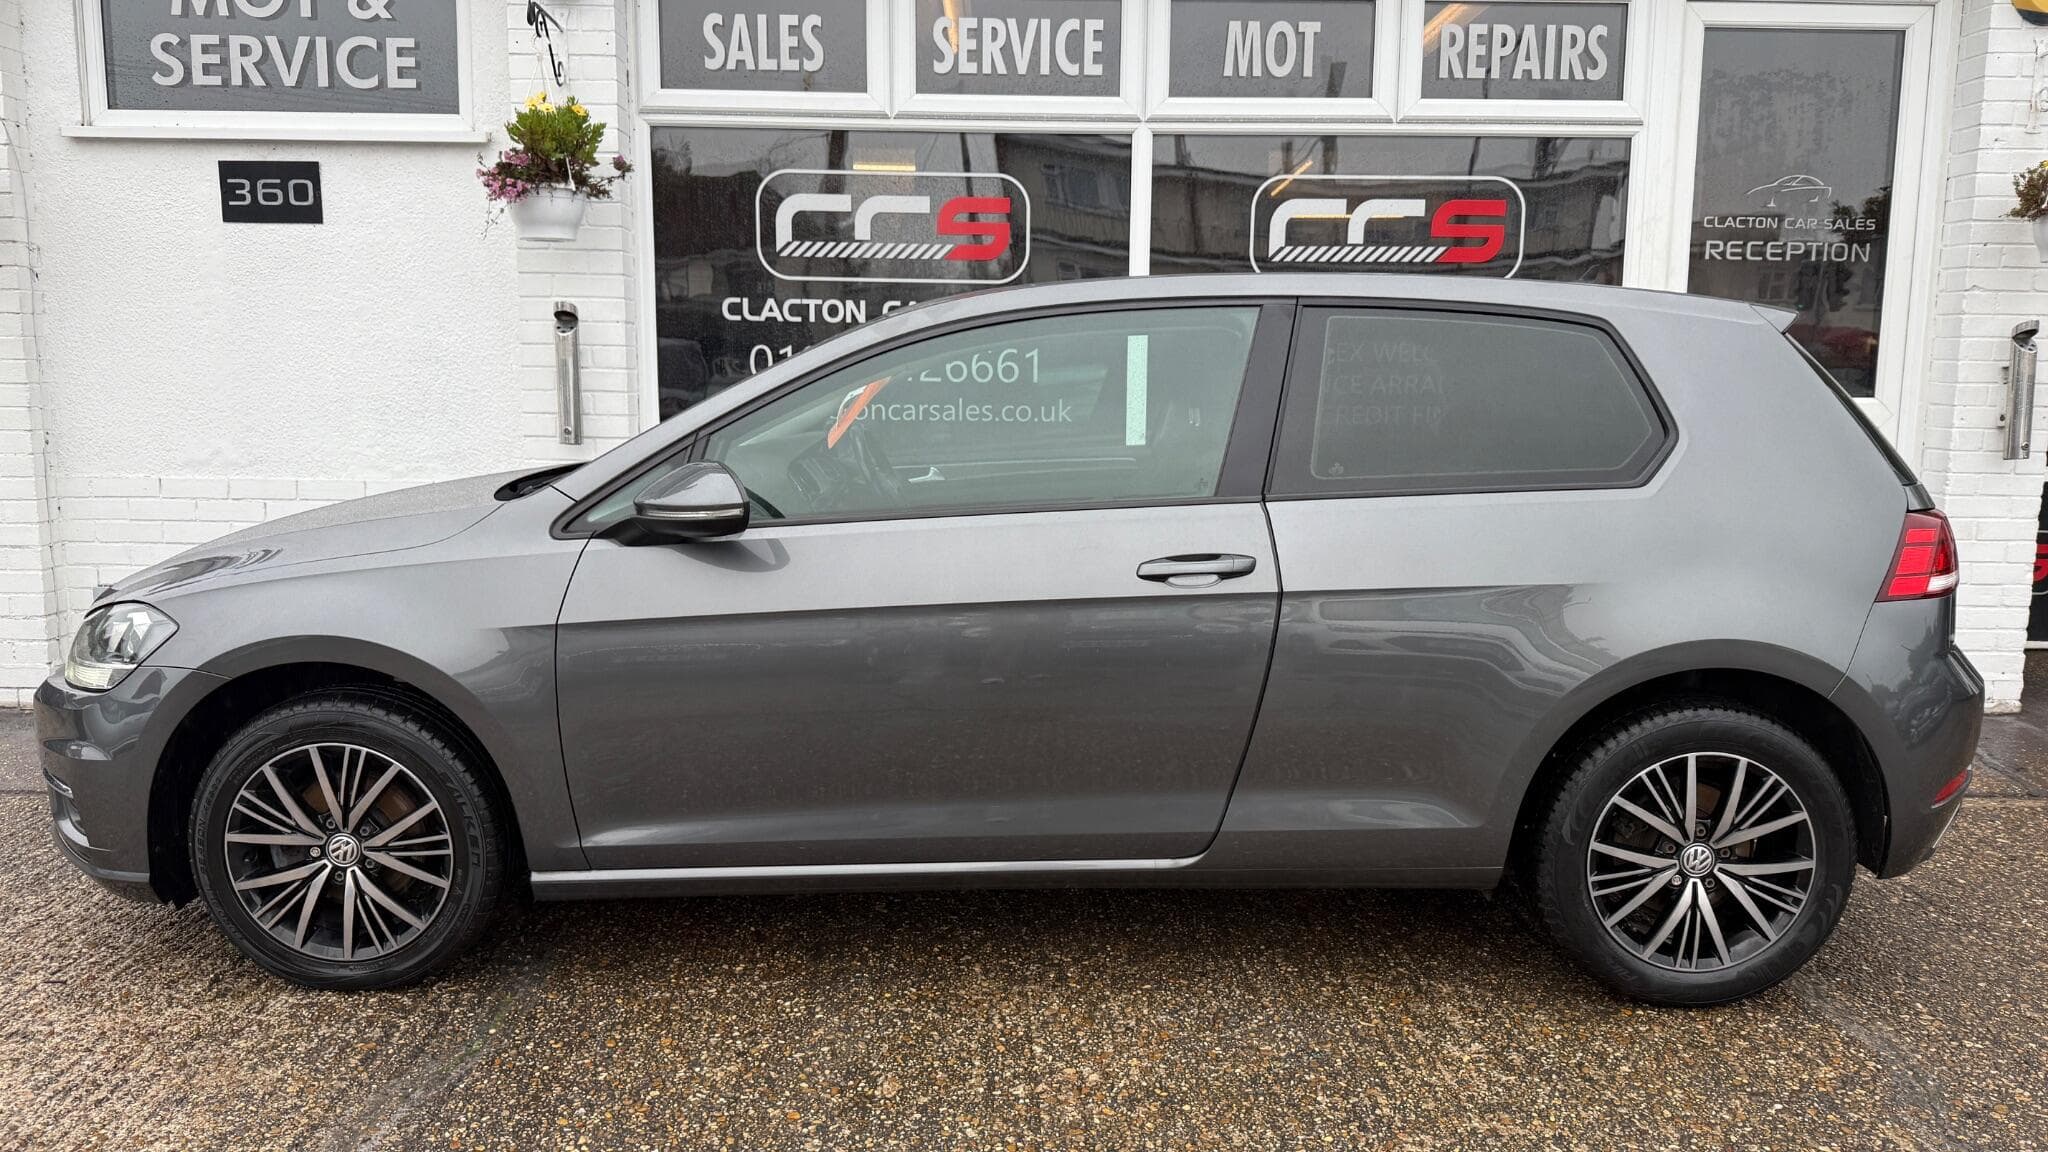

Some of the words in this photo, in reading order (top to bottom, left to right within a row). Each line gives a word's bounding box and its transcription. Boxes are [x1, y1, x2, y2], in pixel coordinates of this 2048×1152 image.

[150, 32, 418, 89] SERVICE
[702, 12, 824, 73] SALES
[932, 16, 1105, 76] SERVICE
[1222, 20, 1322, 78] MOT
[1438, 23, 1609, 82] REPAIRS
[226, 178, 315, 206] 360
[1703, 216, 1778, 229] CLACTON
[1784, 217, 1818, 230] CAR
[1823, 218, 1877, 231] SALES
[1704, 240, 1872, 263] RECEPTION
[721, 297, 867, 324] CLACTON
